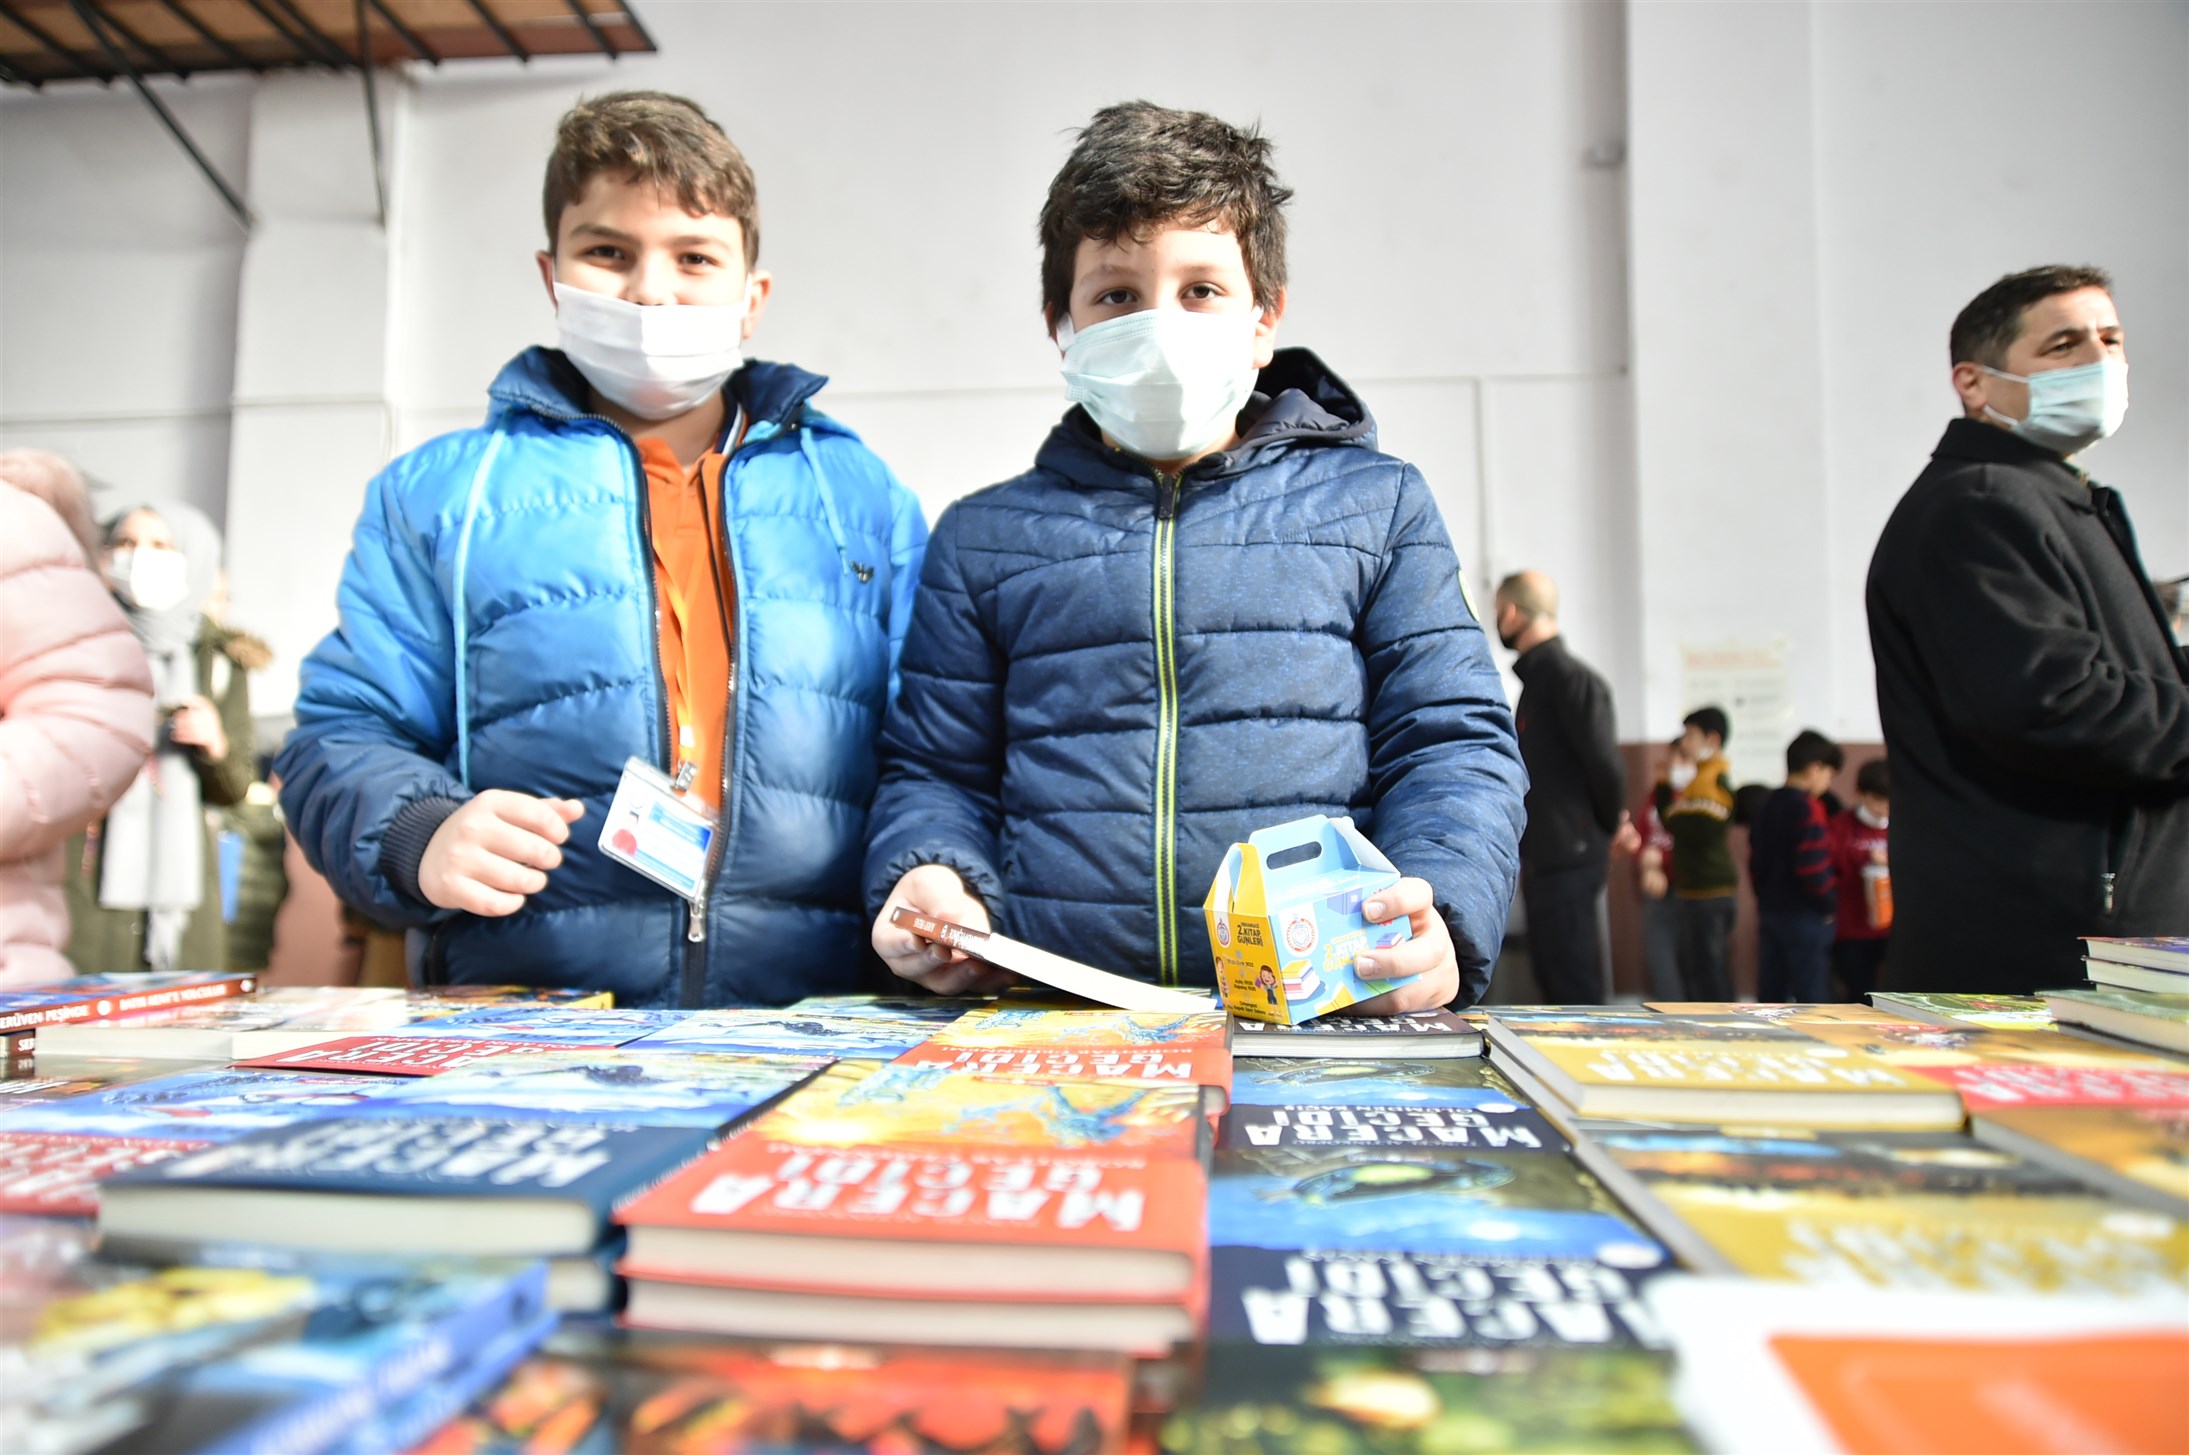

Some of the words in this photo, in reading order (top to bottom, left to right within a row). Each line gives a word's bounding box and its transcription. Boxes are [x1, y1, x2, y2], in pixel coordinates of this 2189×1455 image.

[276, 1049, 474, 1068] ACERA
[1244, 1123, 1543, 1149] MACERA
[690, 1172, 1145, 1232] MACERA
